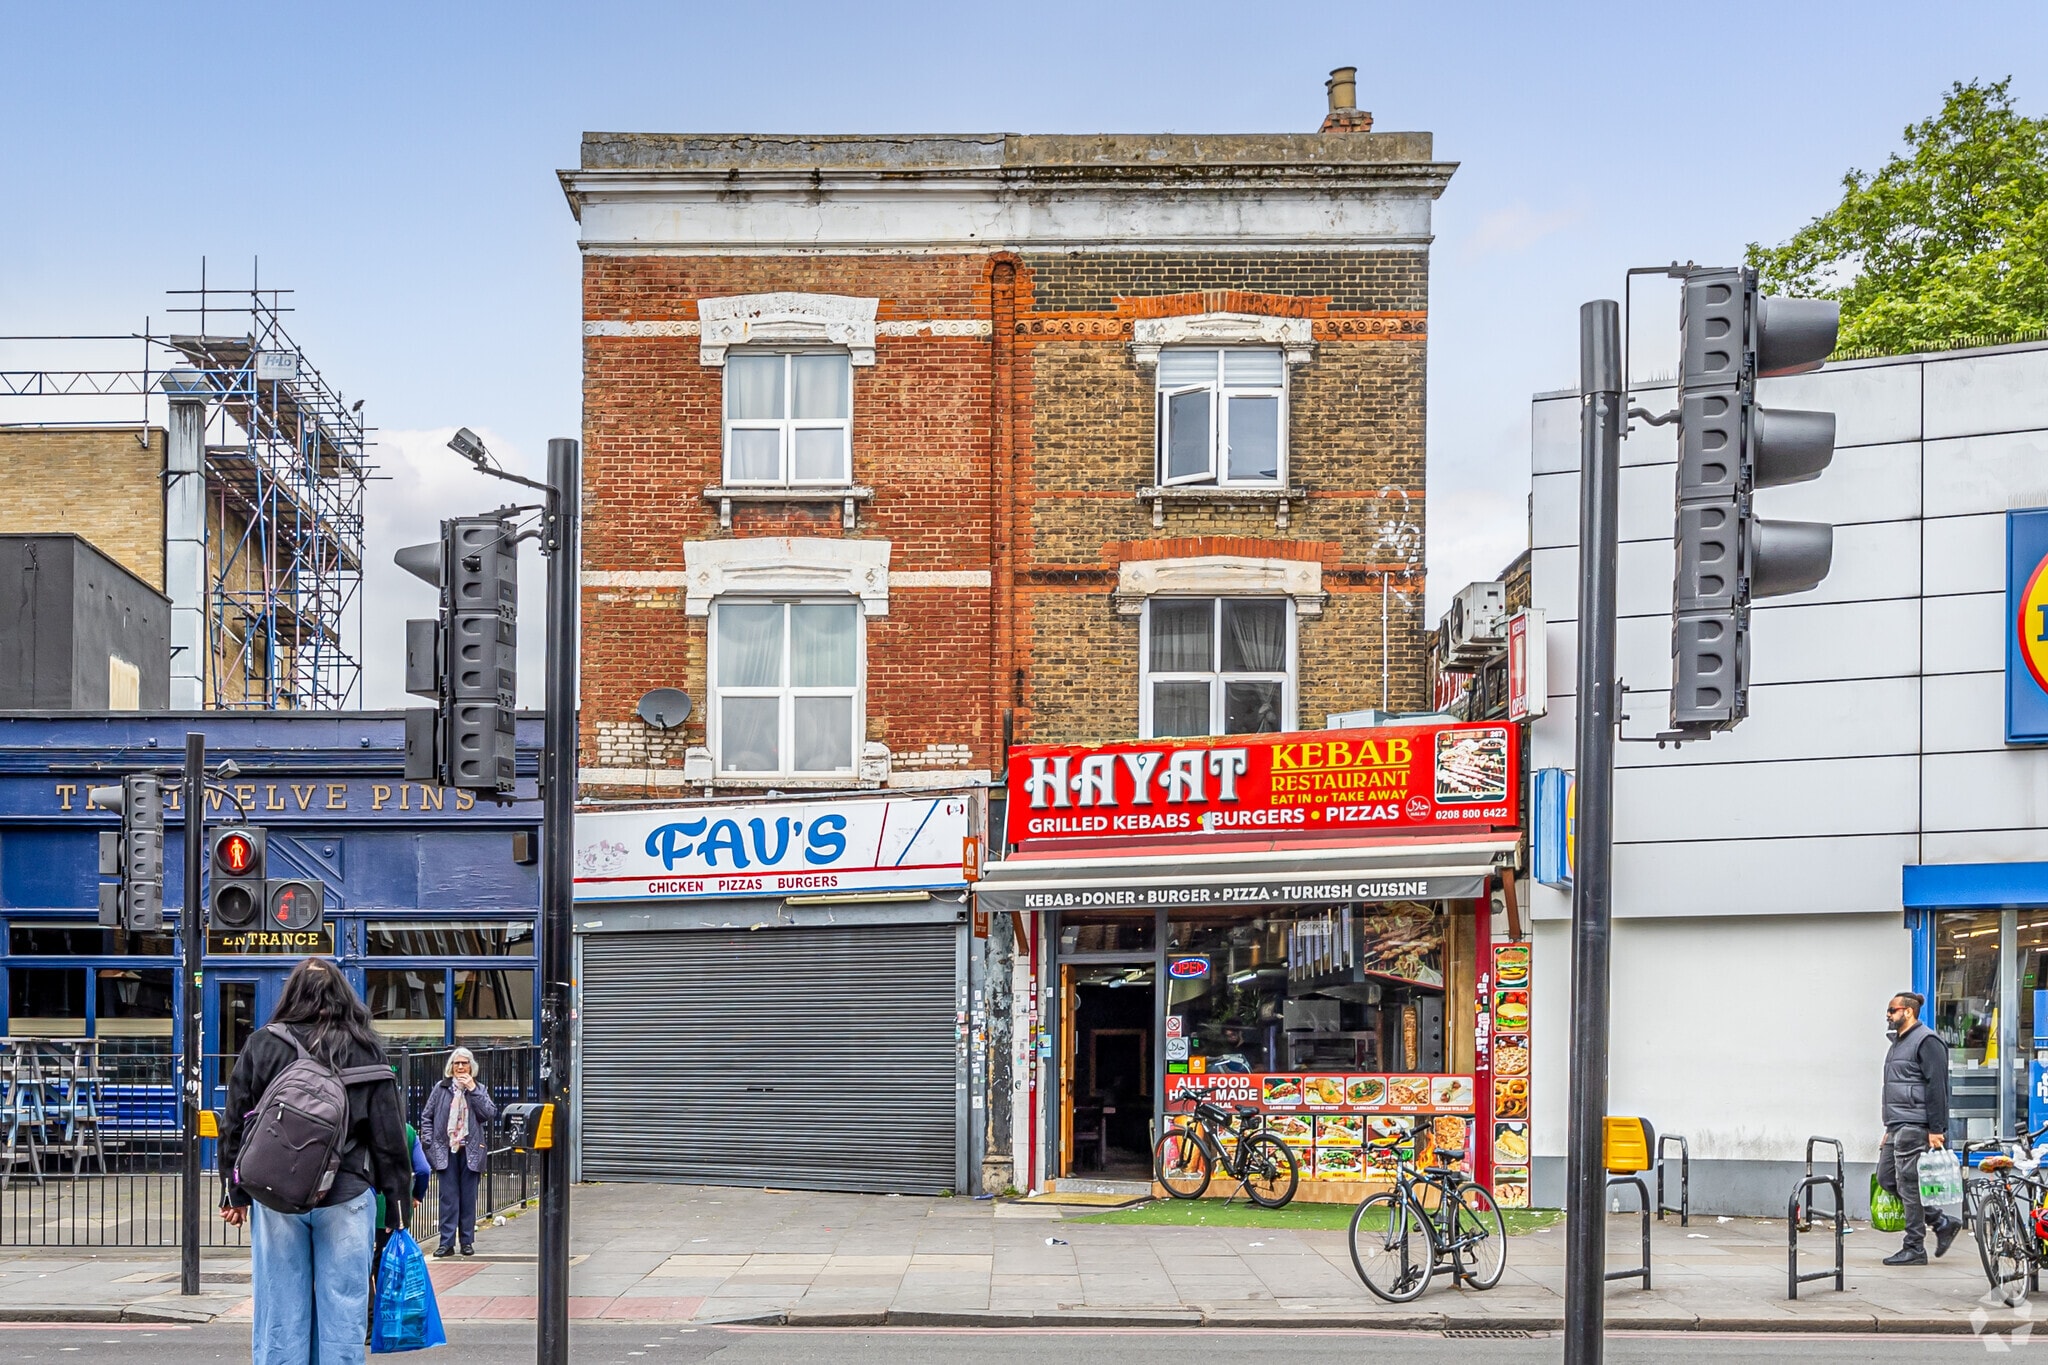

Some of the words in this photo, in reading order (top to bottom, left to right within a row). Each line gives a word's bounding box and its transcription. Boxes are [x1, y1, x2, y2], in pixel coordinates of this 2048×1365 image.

[1270, 737, 1413, 769] KEBAB
[1024, 748, 1248, 808] HAYAT
[1271, 770, 1410, 792] RESTAURANT
[371, 784, 475, 811] PINS
[1270, 794, 1295, 805] EAT
[1297, 793, 1312, 804] IN
[1315, 795, 1329, 803] or
[1331, 791, 1365, 802] TAKE
[1368, 789, 1408, 801] AWAY
[1028, 815, 1108, 833] GRILLED
[1113, 812, 1190, 830] KEBABS
[1212, 808, 1305, 827] BURGERS
[1325, 804, 1400, 822] PIZZAS
[1435, 809, 1460, 820] 0208
[1462, 808, 1481, 819] 800
[1482, 807, 1508, 818] 6422
[648, 880, 704, 894] CHICKEN
[718, 878, 763, 892] PIZZAS
[777, 875, 838, 889] BURGERS
[1025, 893, 1074, 907] KEBAB
[1082, 891, 1136, 905] DONER
[1147, 888, 1211, 904] BURGER
[1222, 886, 1270, 901] PIZZA
[1281, 884, 1353, 899] TURKISH
[1356, 881, 1428, 898] CUISINE
[222, 932, 319, 946] ENTRANCE
[1173, 961, 1206, 975] OPEN
[1176, 1077, 1205, 1089] ALL
[1208, 1077, 1250, 1089] FOOD
[1215, 1089, 1258, 1101] MADE
[1877, 1211, 1906, 1220] REPEA
